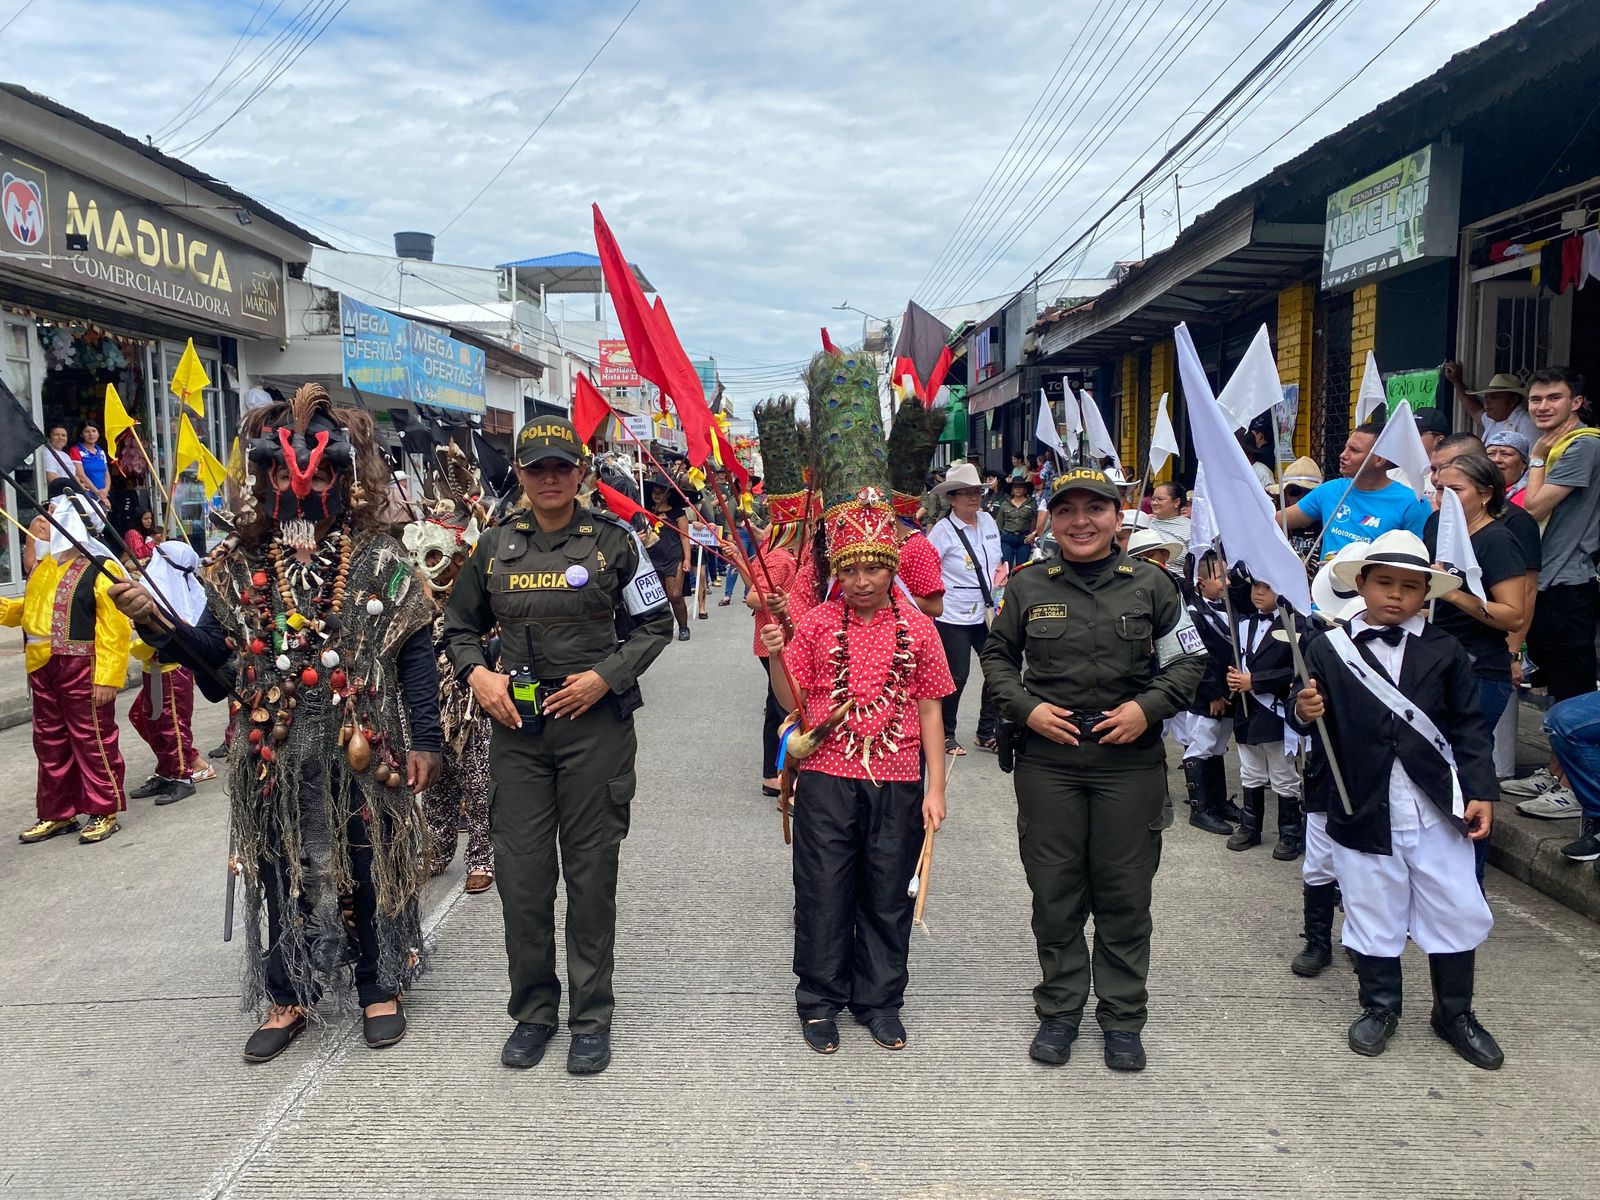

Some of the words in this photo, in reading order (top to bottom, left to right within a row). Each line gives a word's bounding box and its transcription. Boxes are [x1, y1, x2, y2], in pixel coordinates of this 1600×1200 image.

[1352, 188, 1373, 204] TIENDA
[1374, 184, 1382, 195] DE
[1382, 176, 1400, 193] ROPA
[65, 190, 233, 293] MADUCA
[72, 254, 231, 317] COMERCIALIZADORA
[251, 278, 269, 298] SAN
[245, 293, 277, 317] MARTIN
[344, 309, 390, 336] MEGA
[346, 337, 402, 362] OFERTAS
[414, 329, 454, 361] MEGA
[423, 356, 473, 387] OFERTAS
[1419, 378, 1433, 394] DE
[520, 424, 574, 445] POLICIA
[1052, 469, 1106, 491] POLICIA
[1330, 526, 1372, 544] Motorsport
[509, 573, 568, 590] POLICIA
